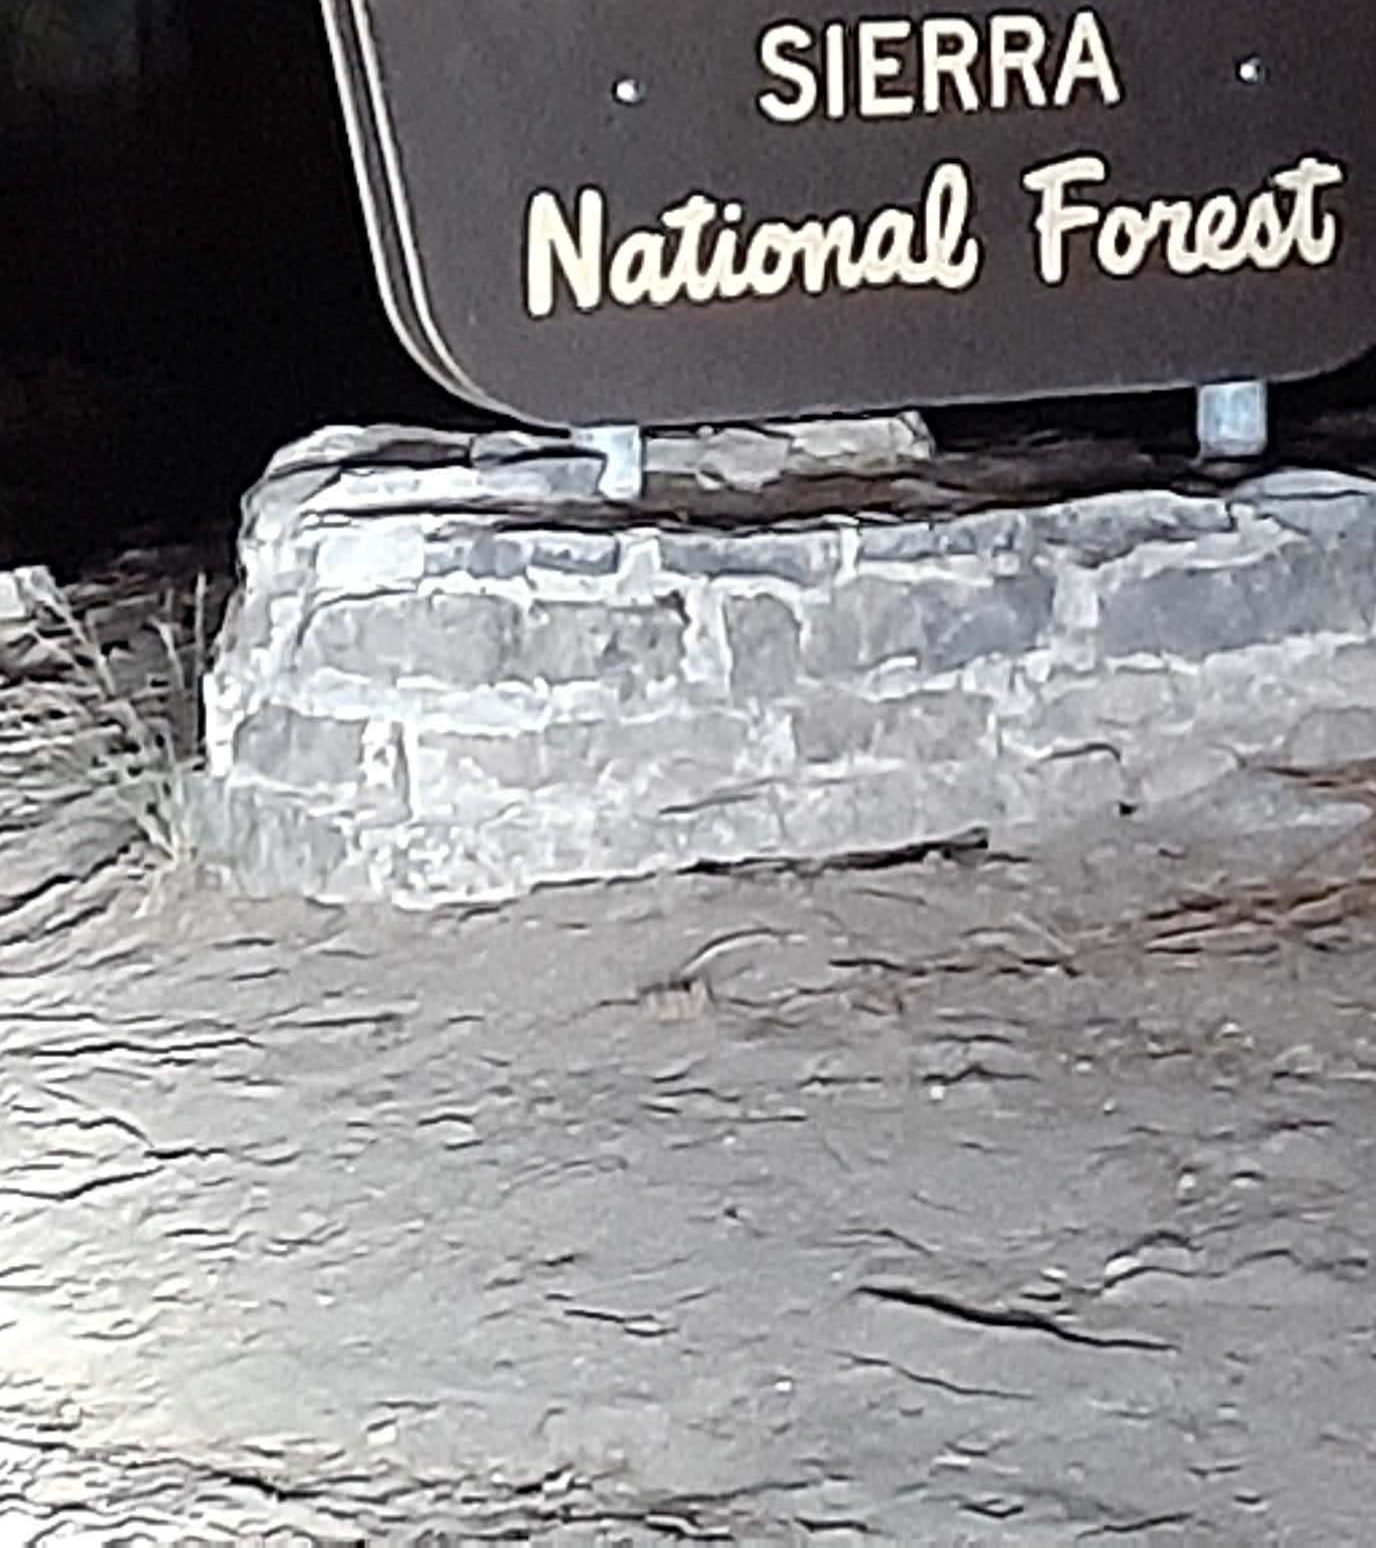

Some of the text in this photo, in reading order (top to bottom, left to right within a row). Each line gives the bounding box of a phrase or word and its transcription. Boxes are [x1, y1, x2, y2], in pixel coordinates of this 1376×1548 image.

[758, 10, 1121, 122] SIERRA
[526, 156, 1343, 317] National Forest
